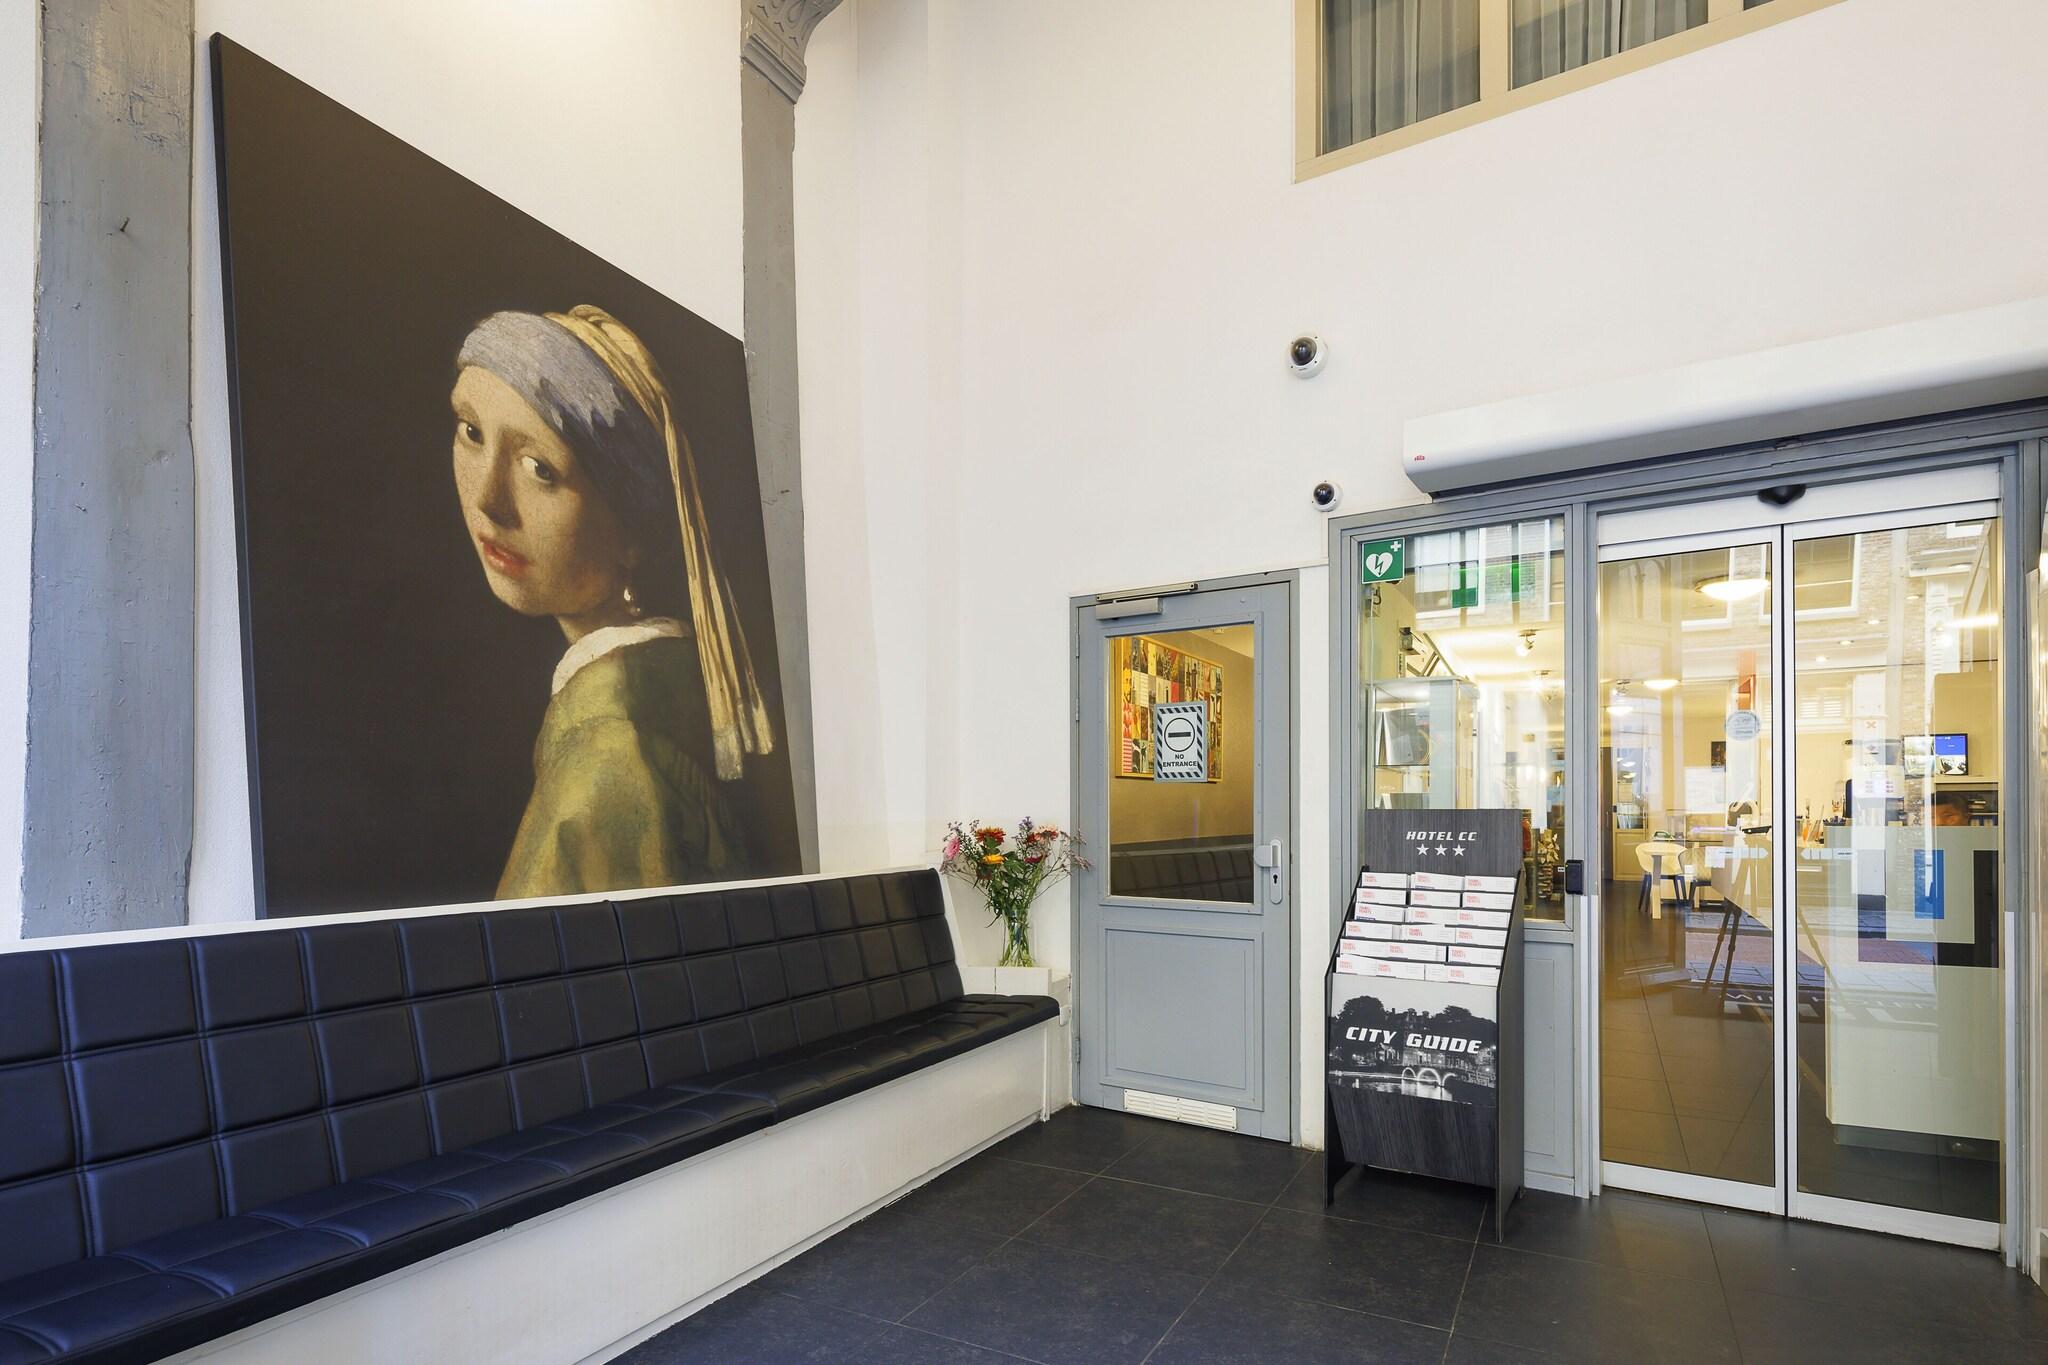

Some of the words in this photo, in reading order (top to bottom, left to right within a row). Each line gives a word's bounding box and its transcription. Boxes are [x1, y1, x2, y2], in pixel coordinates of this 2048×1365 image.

[1406, 831, 1454, 841] HOTEL
[1458, 831, 1478, 841] CC
[1345, 1026, 1397, 1044] CITY
[1406, 1033, 1482, 1054] GUIDE
